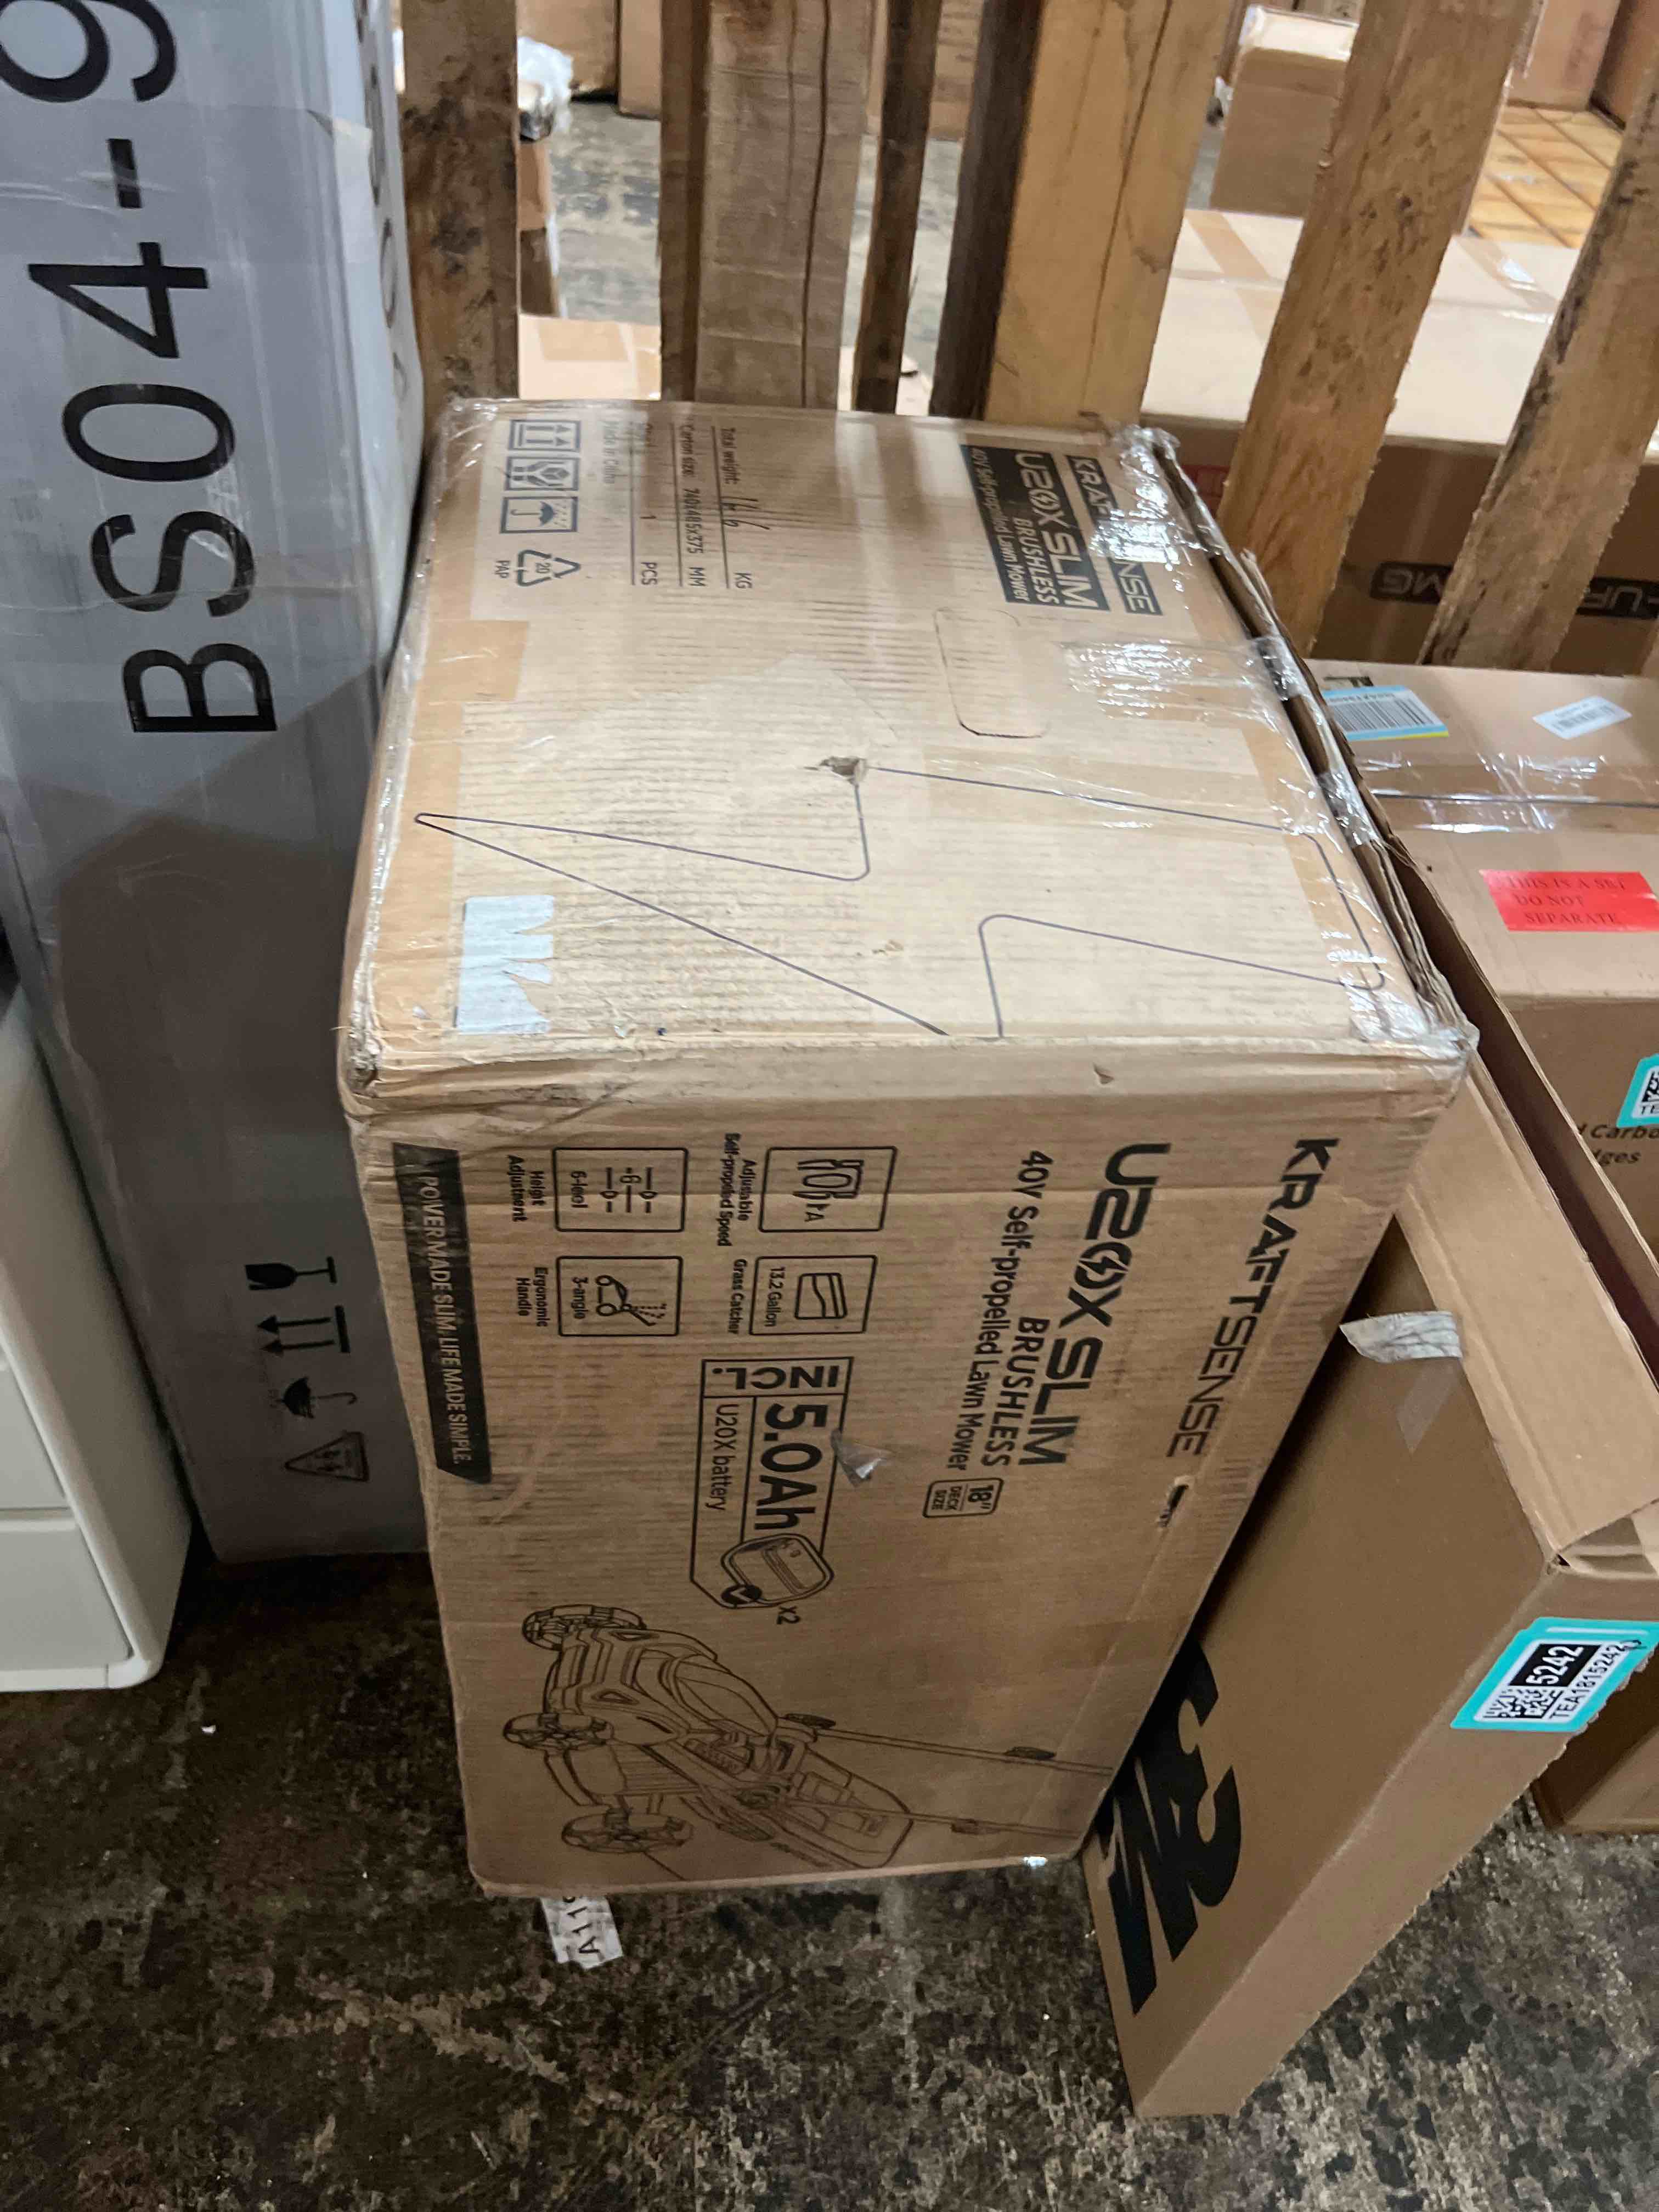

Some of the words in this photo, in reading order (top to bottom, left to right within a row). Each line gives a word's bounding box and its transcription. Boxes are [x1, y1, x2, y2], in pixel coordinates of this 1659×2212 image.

[495, 560, 510, 579] PAP
[994, 535, 1019, 562] Lawn
[1013, 518, 1059, 604] BRUSHLESS
[1042, 530, 1098, 608] SLIM
[640, 562, 658, 585] PCS
[689, 566, 706, 587] MM
[734, 572, 752, 590] KG
[1005, 565, 1030, 602] Mower
[1017, 1150, 1053, 1199] 40V
[424, 1239, 452, 1290] MADE
[975, 1206, 1039, 1354] Self-propelled
[534, 1266, 551, 1328] Ergonomic
[728, 1291, 746, 1335] Catcher
[764, 1291, 783, 1328] Gallon
[1166, 1138, 1340, 1458] KRAFTSENSE
[438, 1336, 461, 1366] LIFE
[442, 1368, 467, 1411] MADE
[712, 1365, 839, 1390] INCL.
[961, 1351, 1000, 1409] Lawn
[981, 1317, 1050, 1467] BRUSHLESS
[1018, 1336, 1103, 1466] SLIM
[714, 1404, 740, 1450] U20X
[947, 1413, 985, 1471] Mower
[706, 1455, 736, 1511] battery
[754, 1403, 828, 1530] 5.0Ah
[1526, 1646, 1584, 1685] 5242
